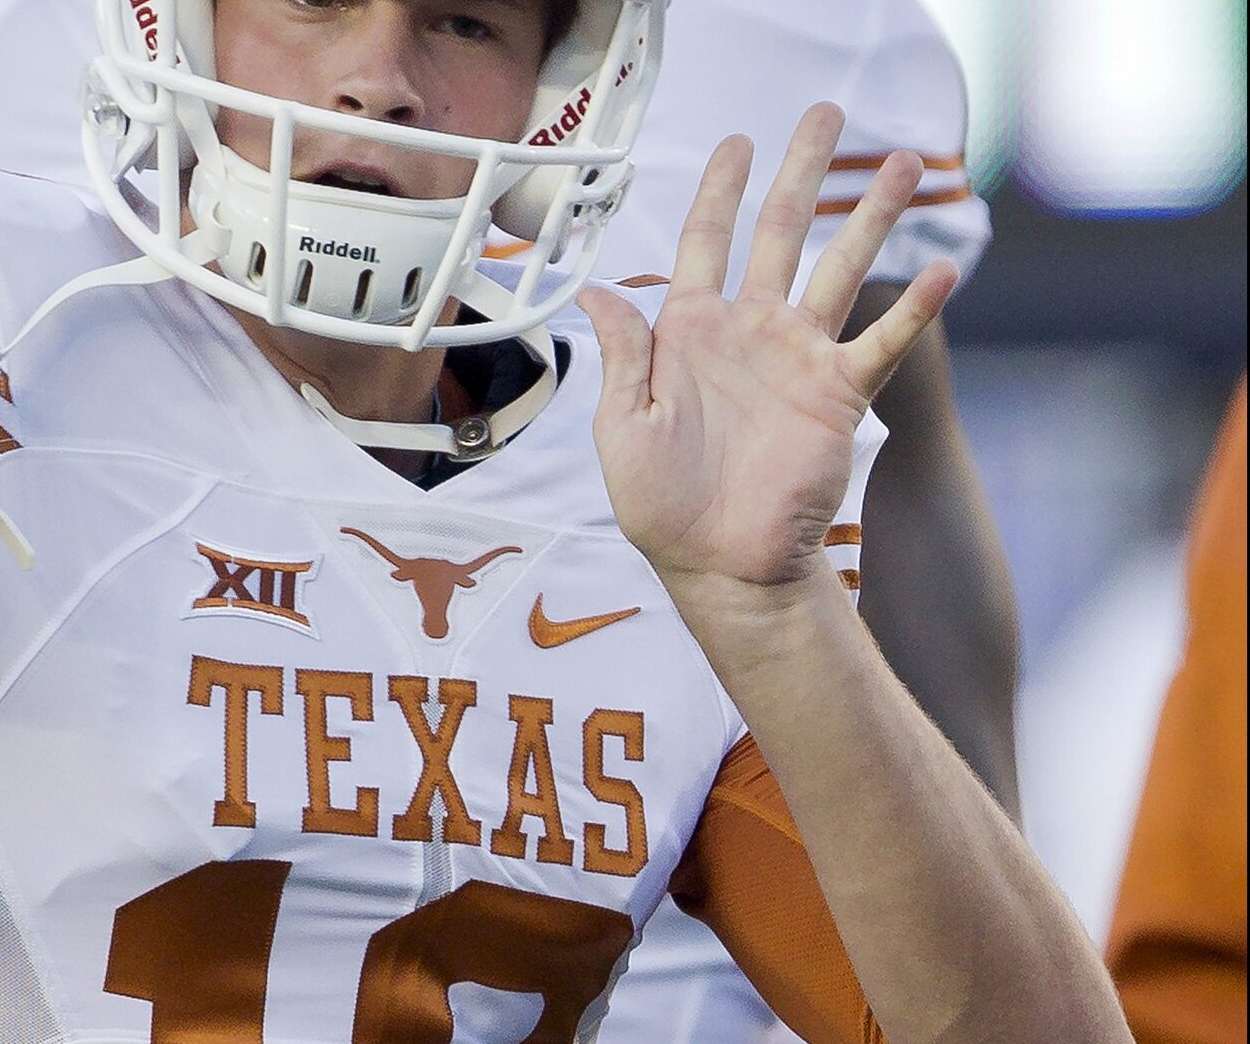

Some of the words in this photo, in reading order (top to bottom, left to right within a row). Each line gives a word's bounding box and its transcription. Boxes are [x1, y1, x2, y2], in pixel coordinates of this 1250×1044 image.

[299, 236, 379, 263] Riddell
[192, 542, 314, 627] XII
[187, 655, 649, 878] TEXAS
